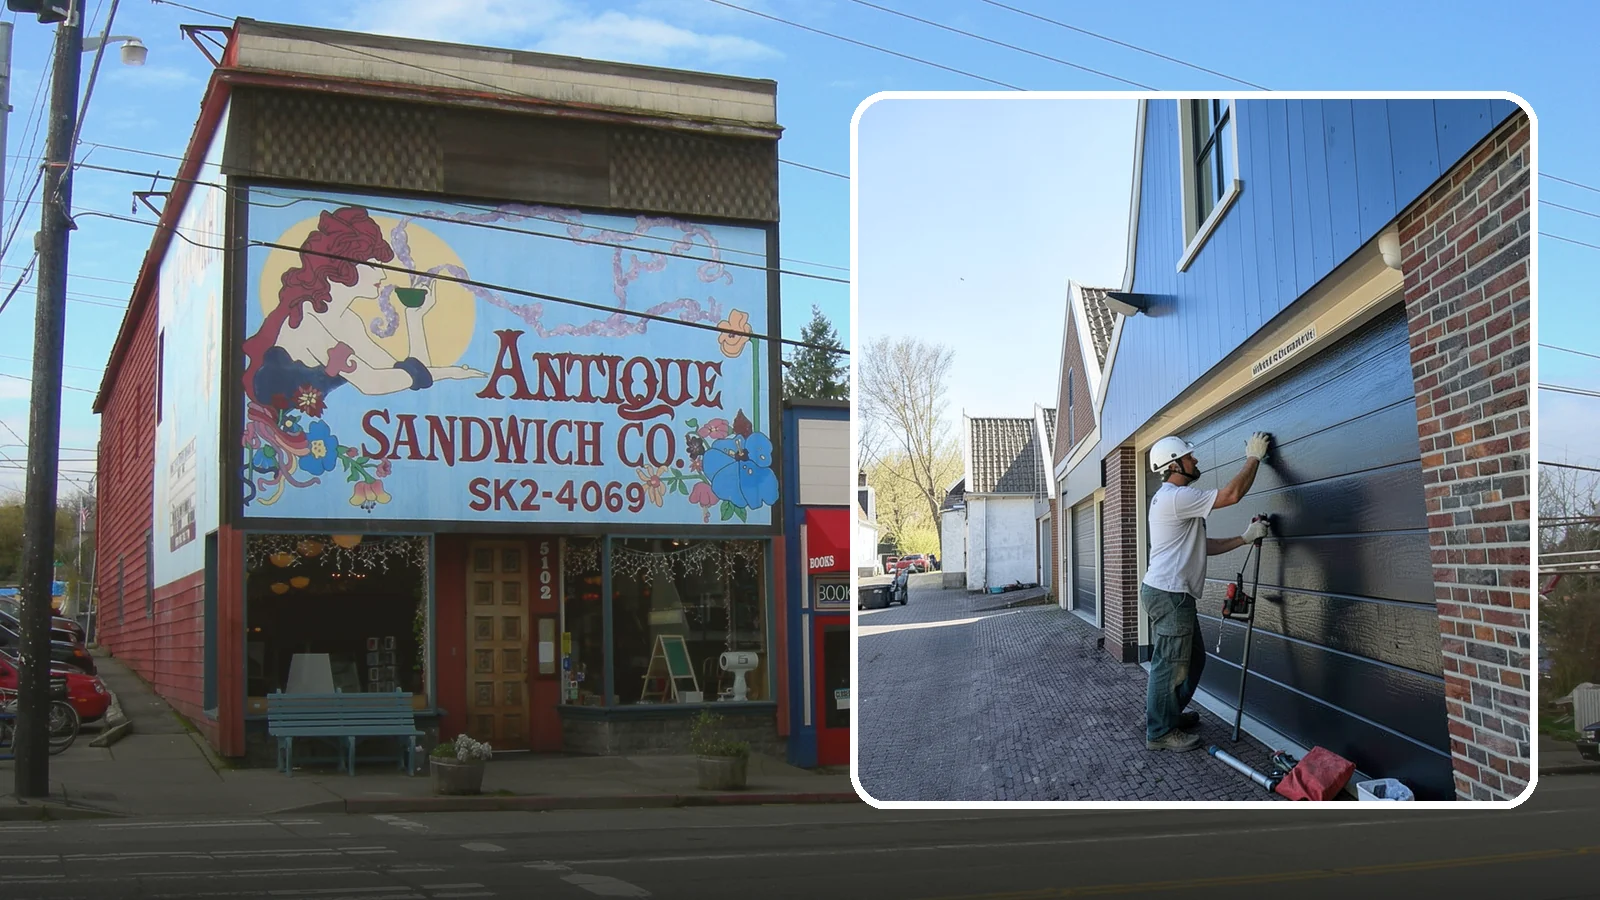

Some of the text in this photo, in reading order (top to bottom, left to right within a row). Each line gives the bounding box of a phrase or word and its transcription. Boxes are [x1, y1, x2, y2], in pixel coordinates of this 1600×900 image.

[475, 329, 723, 421] ANTIQUE
[361, 408, 685, 469] SANDWICH CO.
[468, 476, 646, 513] SK2-4069
[540, 541, 552, 600] 5102
[809, 555, 835, 569] BOOKS
